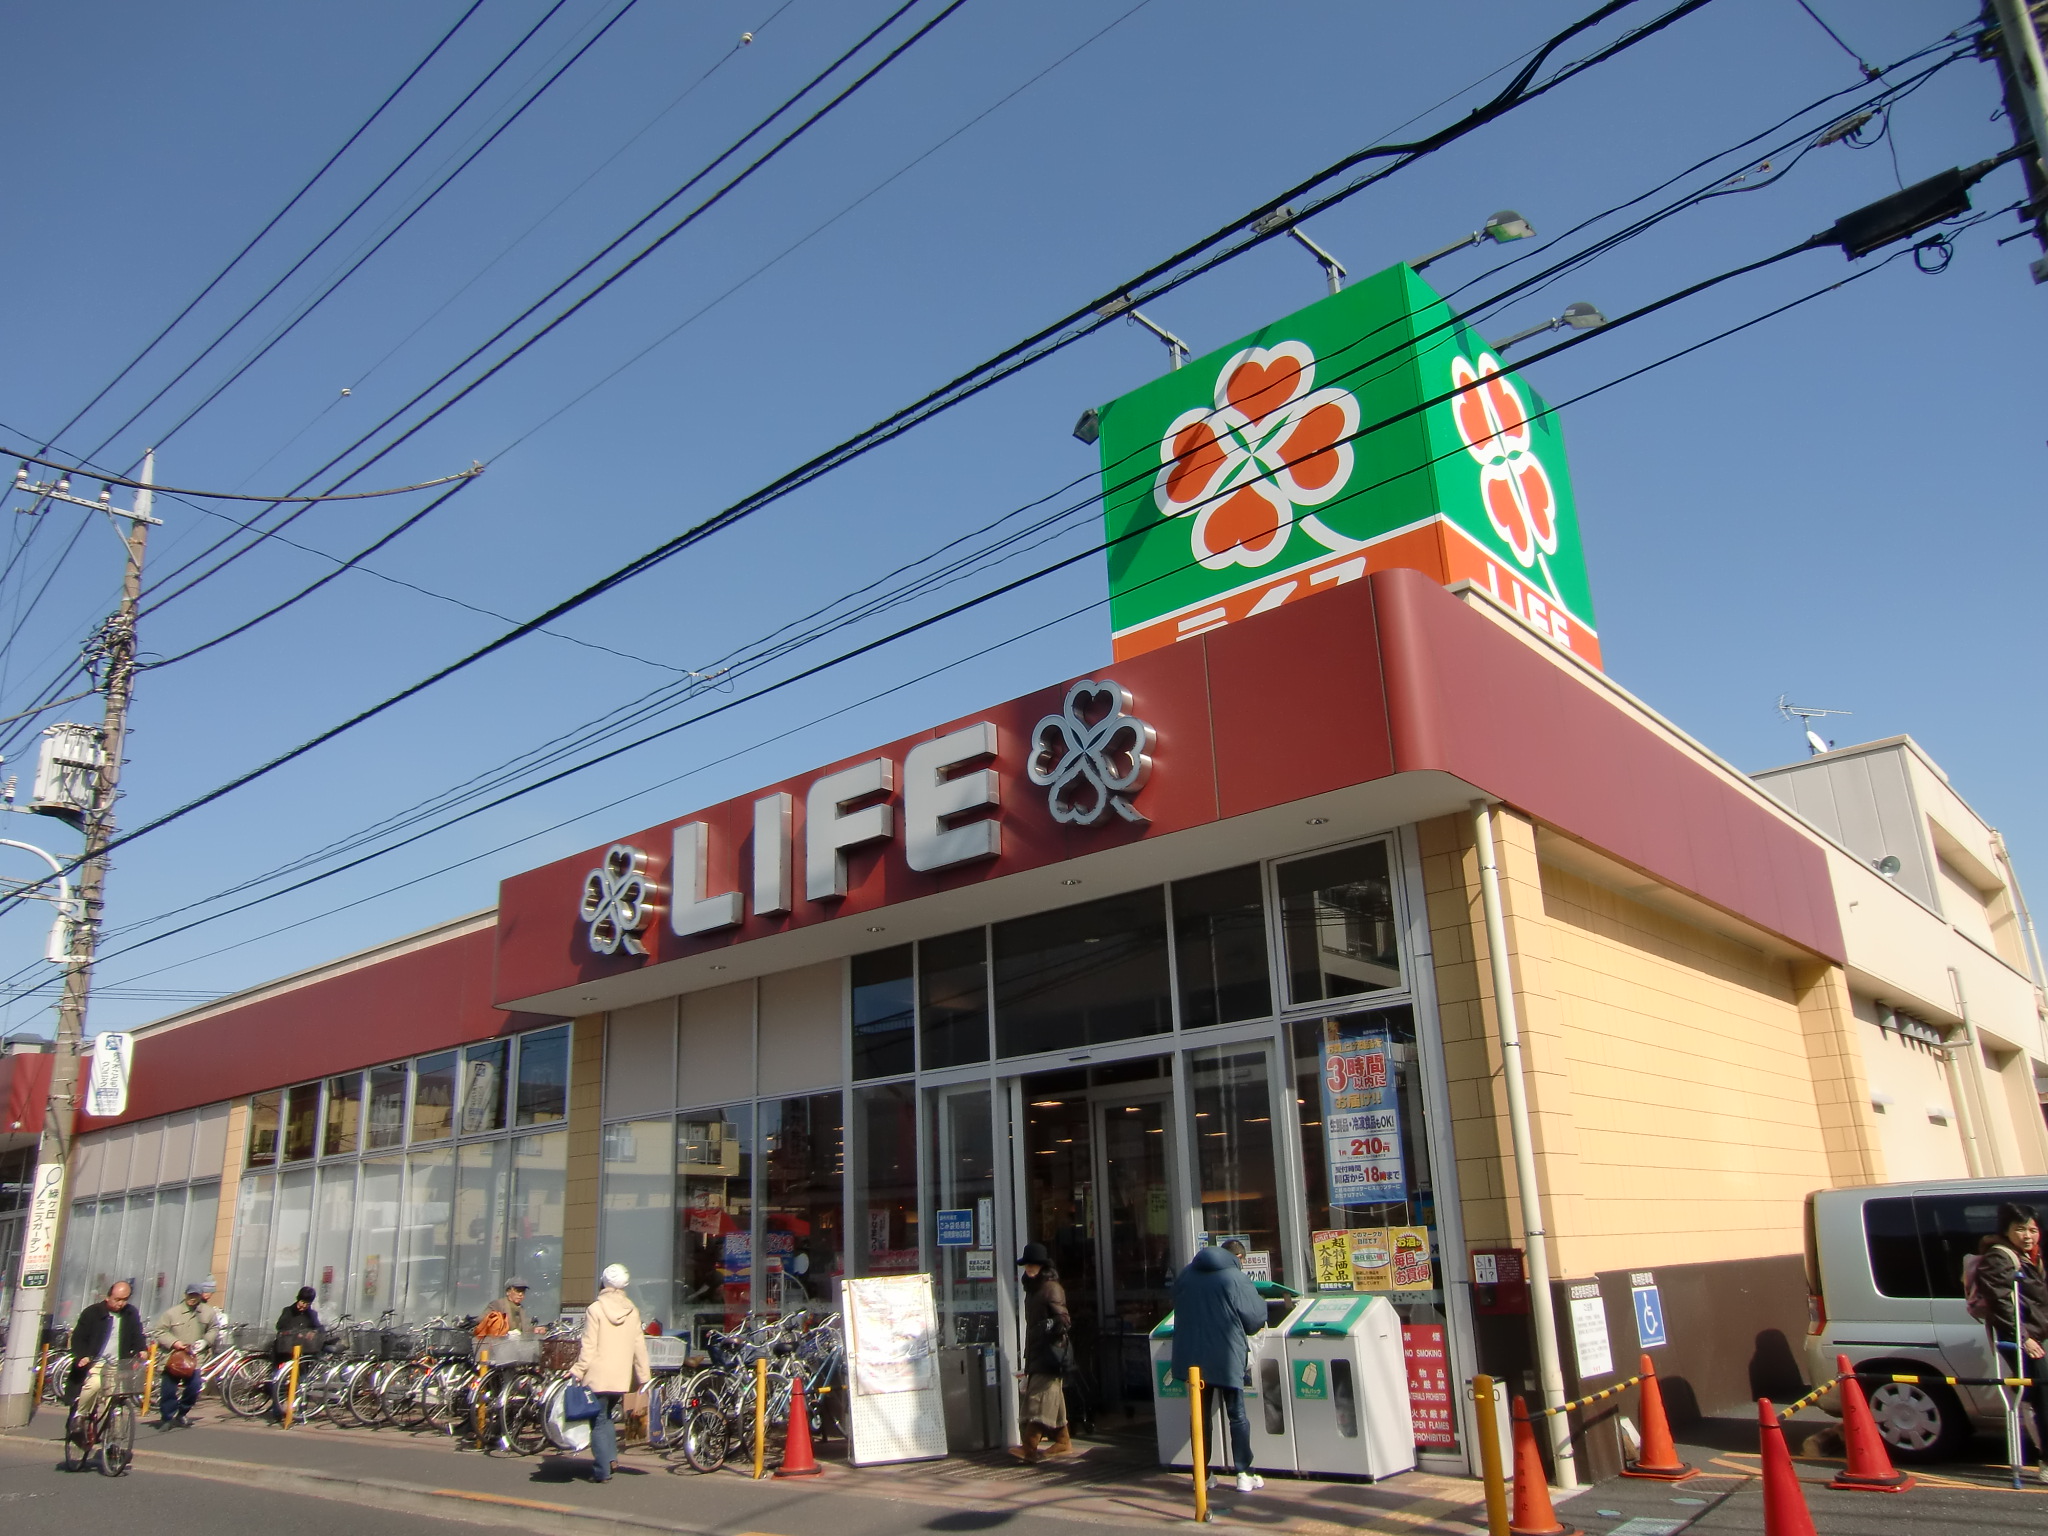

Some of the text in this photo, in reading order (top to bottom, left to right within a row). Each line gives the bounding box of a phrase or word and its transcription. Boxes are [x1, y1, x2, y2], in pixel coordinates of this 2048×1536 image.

[1486, 558, 1572, 649] LIFE
[670, 720, 1002, 938] LIFE
[1353, 1075, 1388, 1091] 以内に
[30, 1199, 46, 1254] テニスガーデン
[1318, 1244, 1335, 1281] 大集合
[1331, 1237, 1349, 1281] 超特価品
[1393, 1251, 1416, 1268] 毎日
[1395, 1264, 1430, 1285] お買得
[1405, 1349, 1442, 1358] NO SMOKING
[1412, 1420, 1450, 1430] OPEN FLAMES
[1413, 1432, 1451, 1442] PROHIBITED
